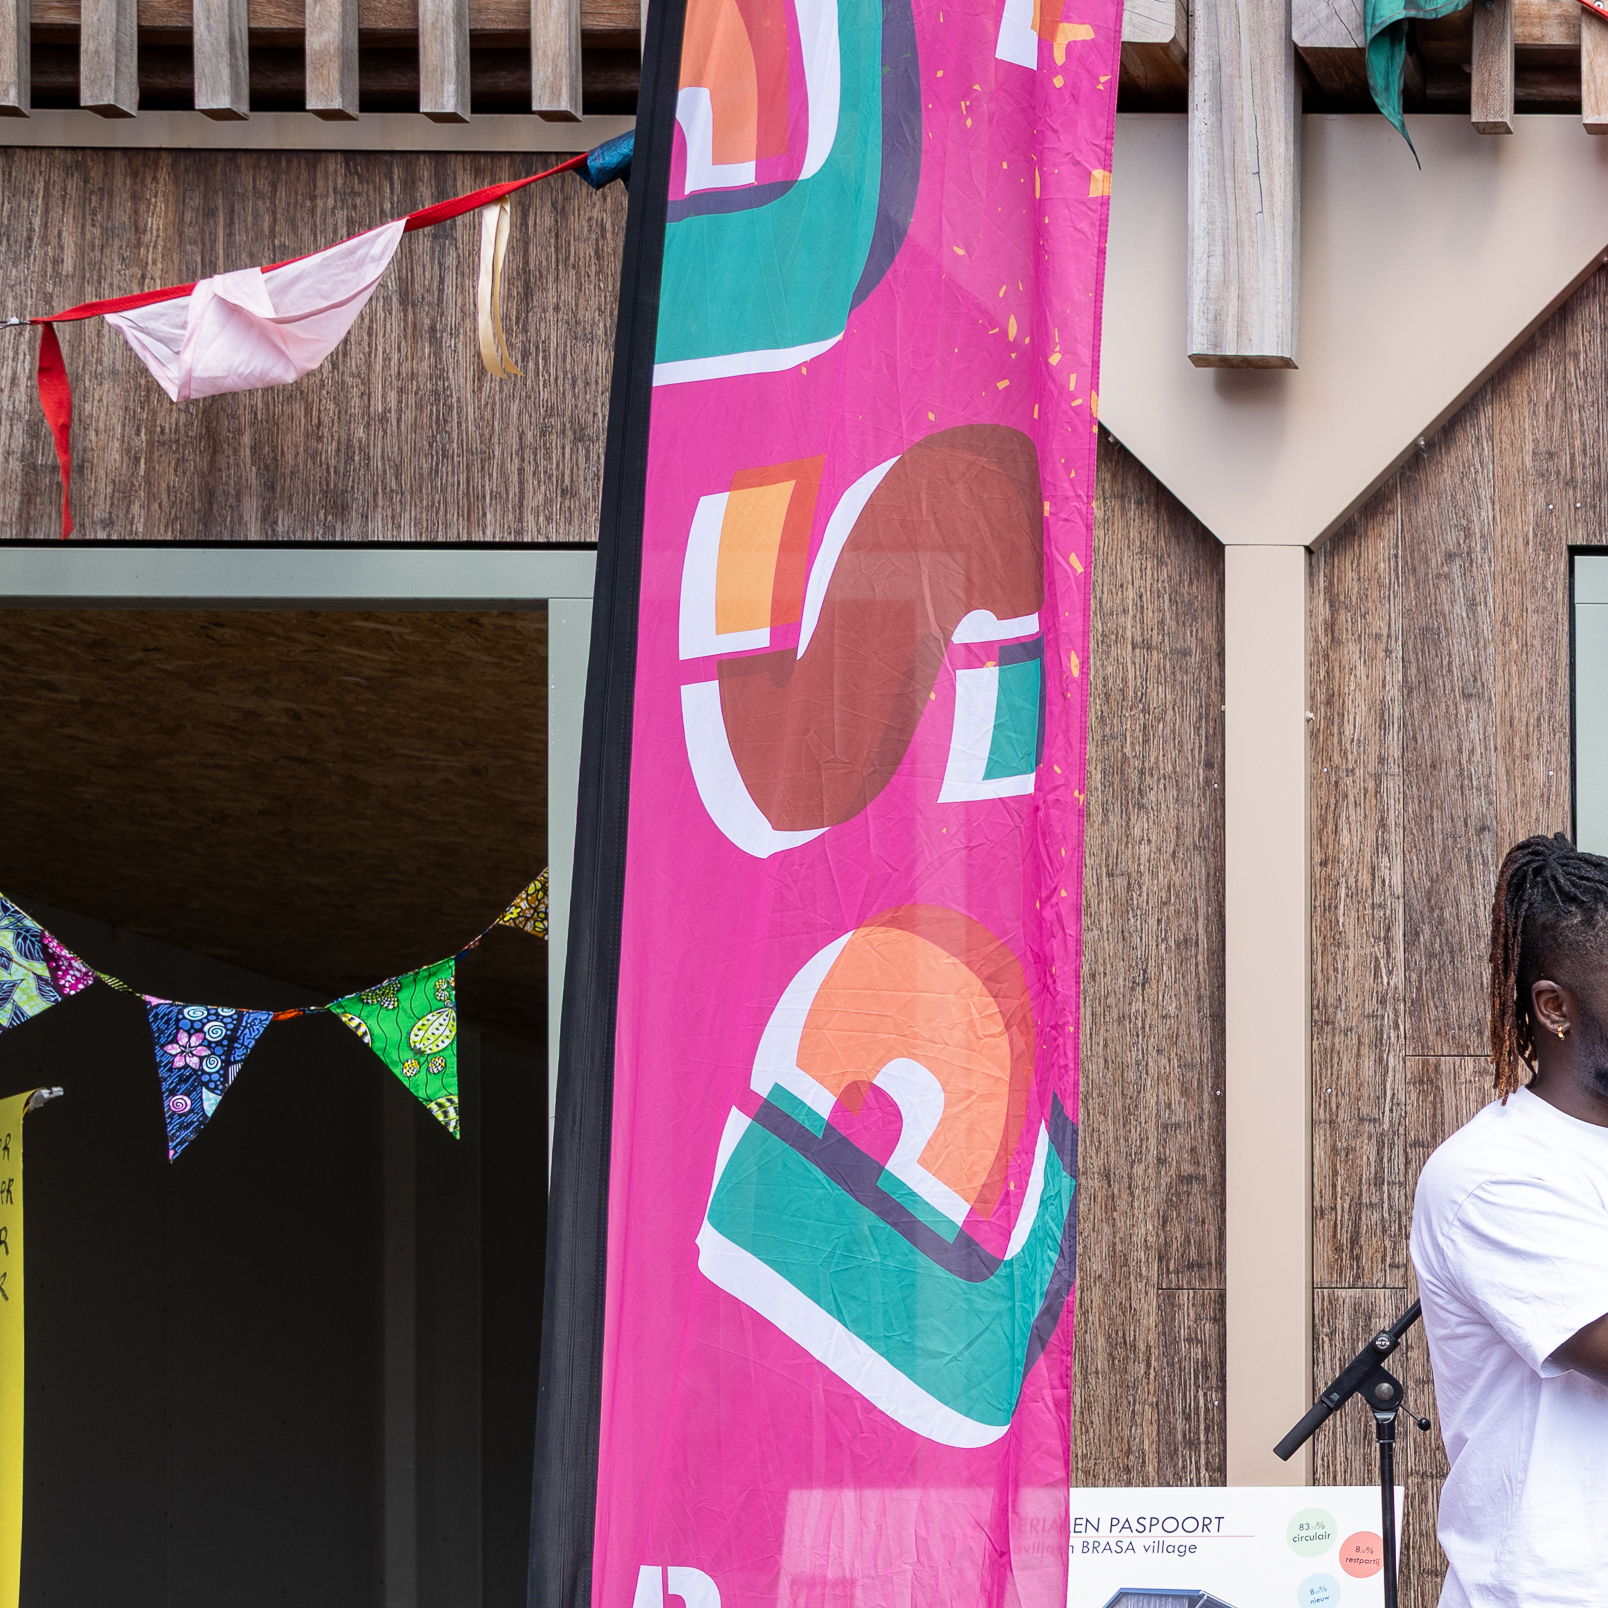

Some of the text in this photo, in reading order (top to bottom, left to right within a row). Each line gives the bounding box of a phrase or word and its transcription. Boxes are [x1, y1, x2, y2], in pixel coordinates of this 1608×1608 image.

[1109, 1516, 1224, 1533] PASPOORT
[1292, 1531, 1331, 1542] circulair
[1081, 1540, 1136, 1554] BRASA
[1143, 1540, 1197, 1557] village
[1345, 1557, 1380, 1566] restpartij
[1310, 1595, 1330, 1604] nieuw
